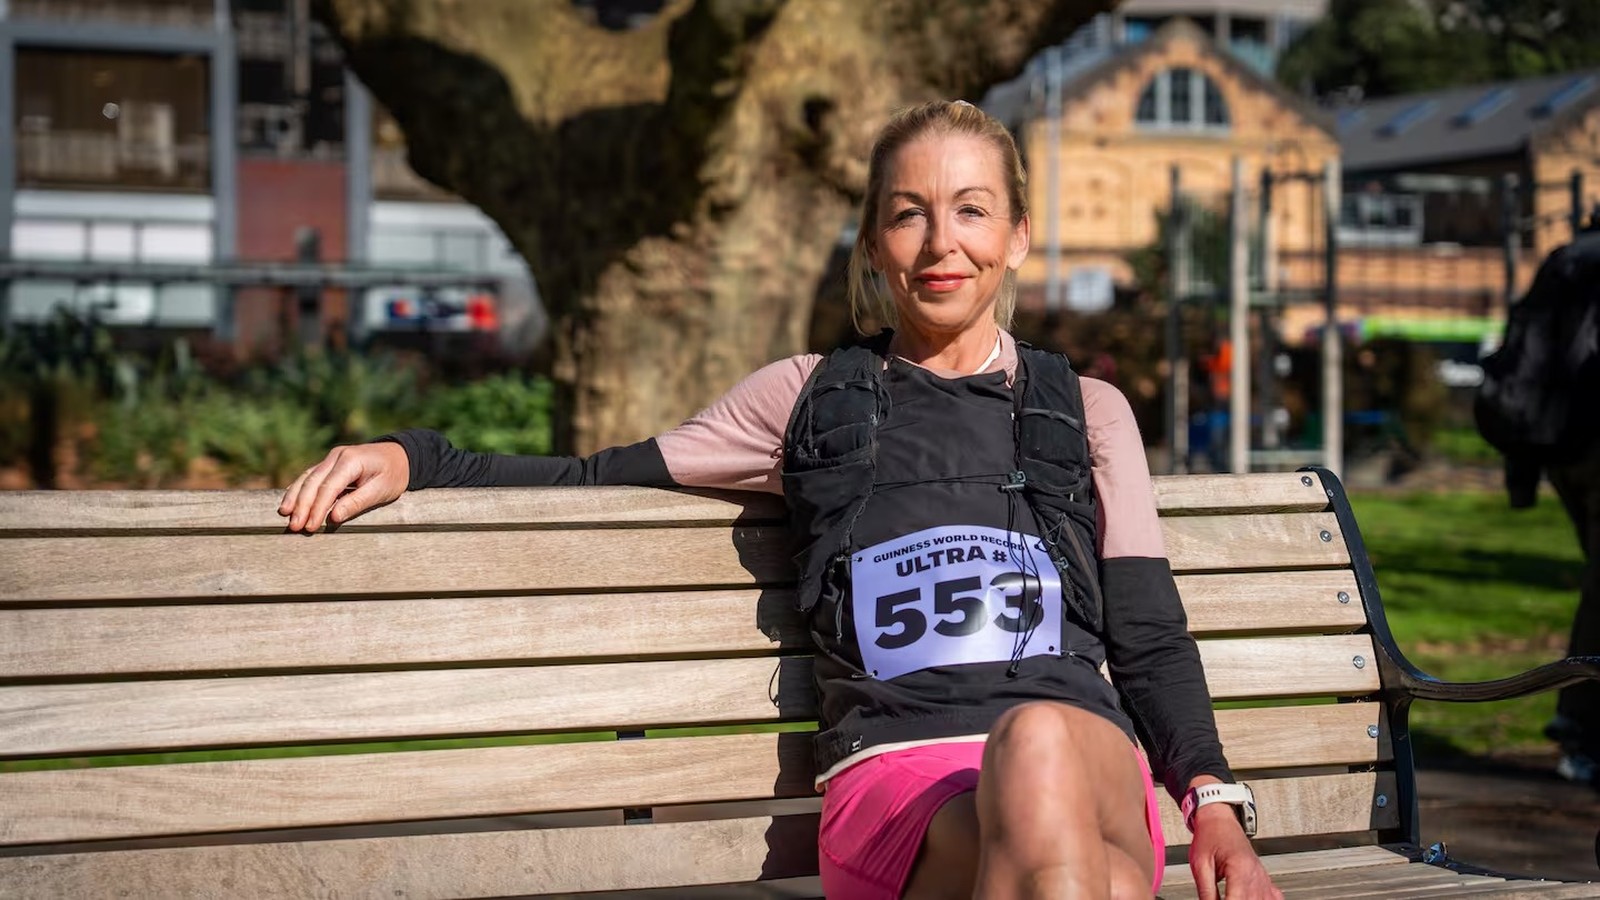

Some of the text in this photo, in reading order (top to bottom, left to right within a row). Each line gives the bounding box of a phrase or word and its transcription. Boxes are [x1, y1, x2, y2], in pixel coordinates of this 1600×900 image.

[873, 540, 931, 563] GUINNESS
[933, 534, 978, 545] WORLD
[896, 545, 1008, 577] ULTRA #
[874, 571, 1045, 650] 553
